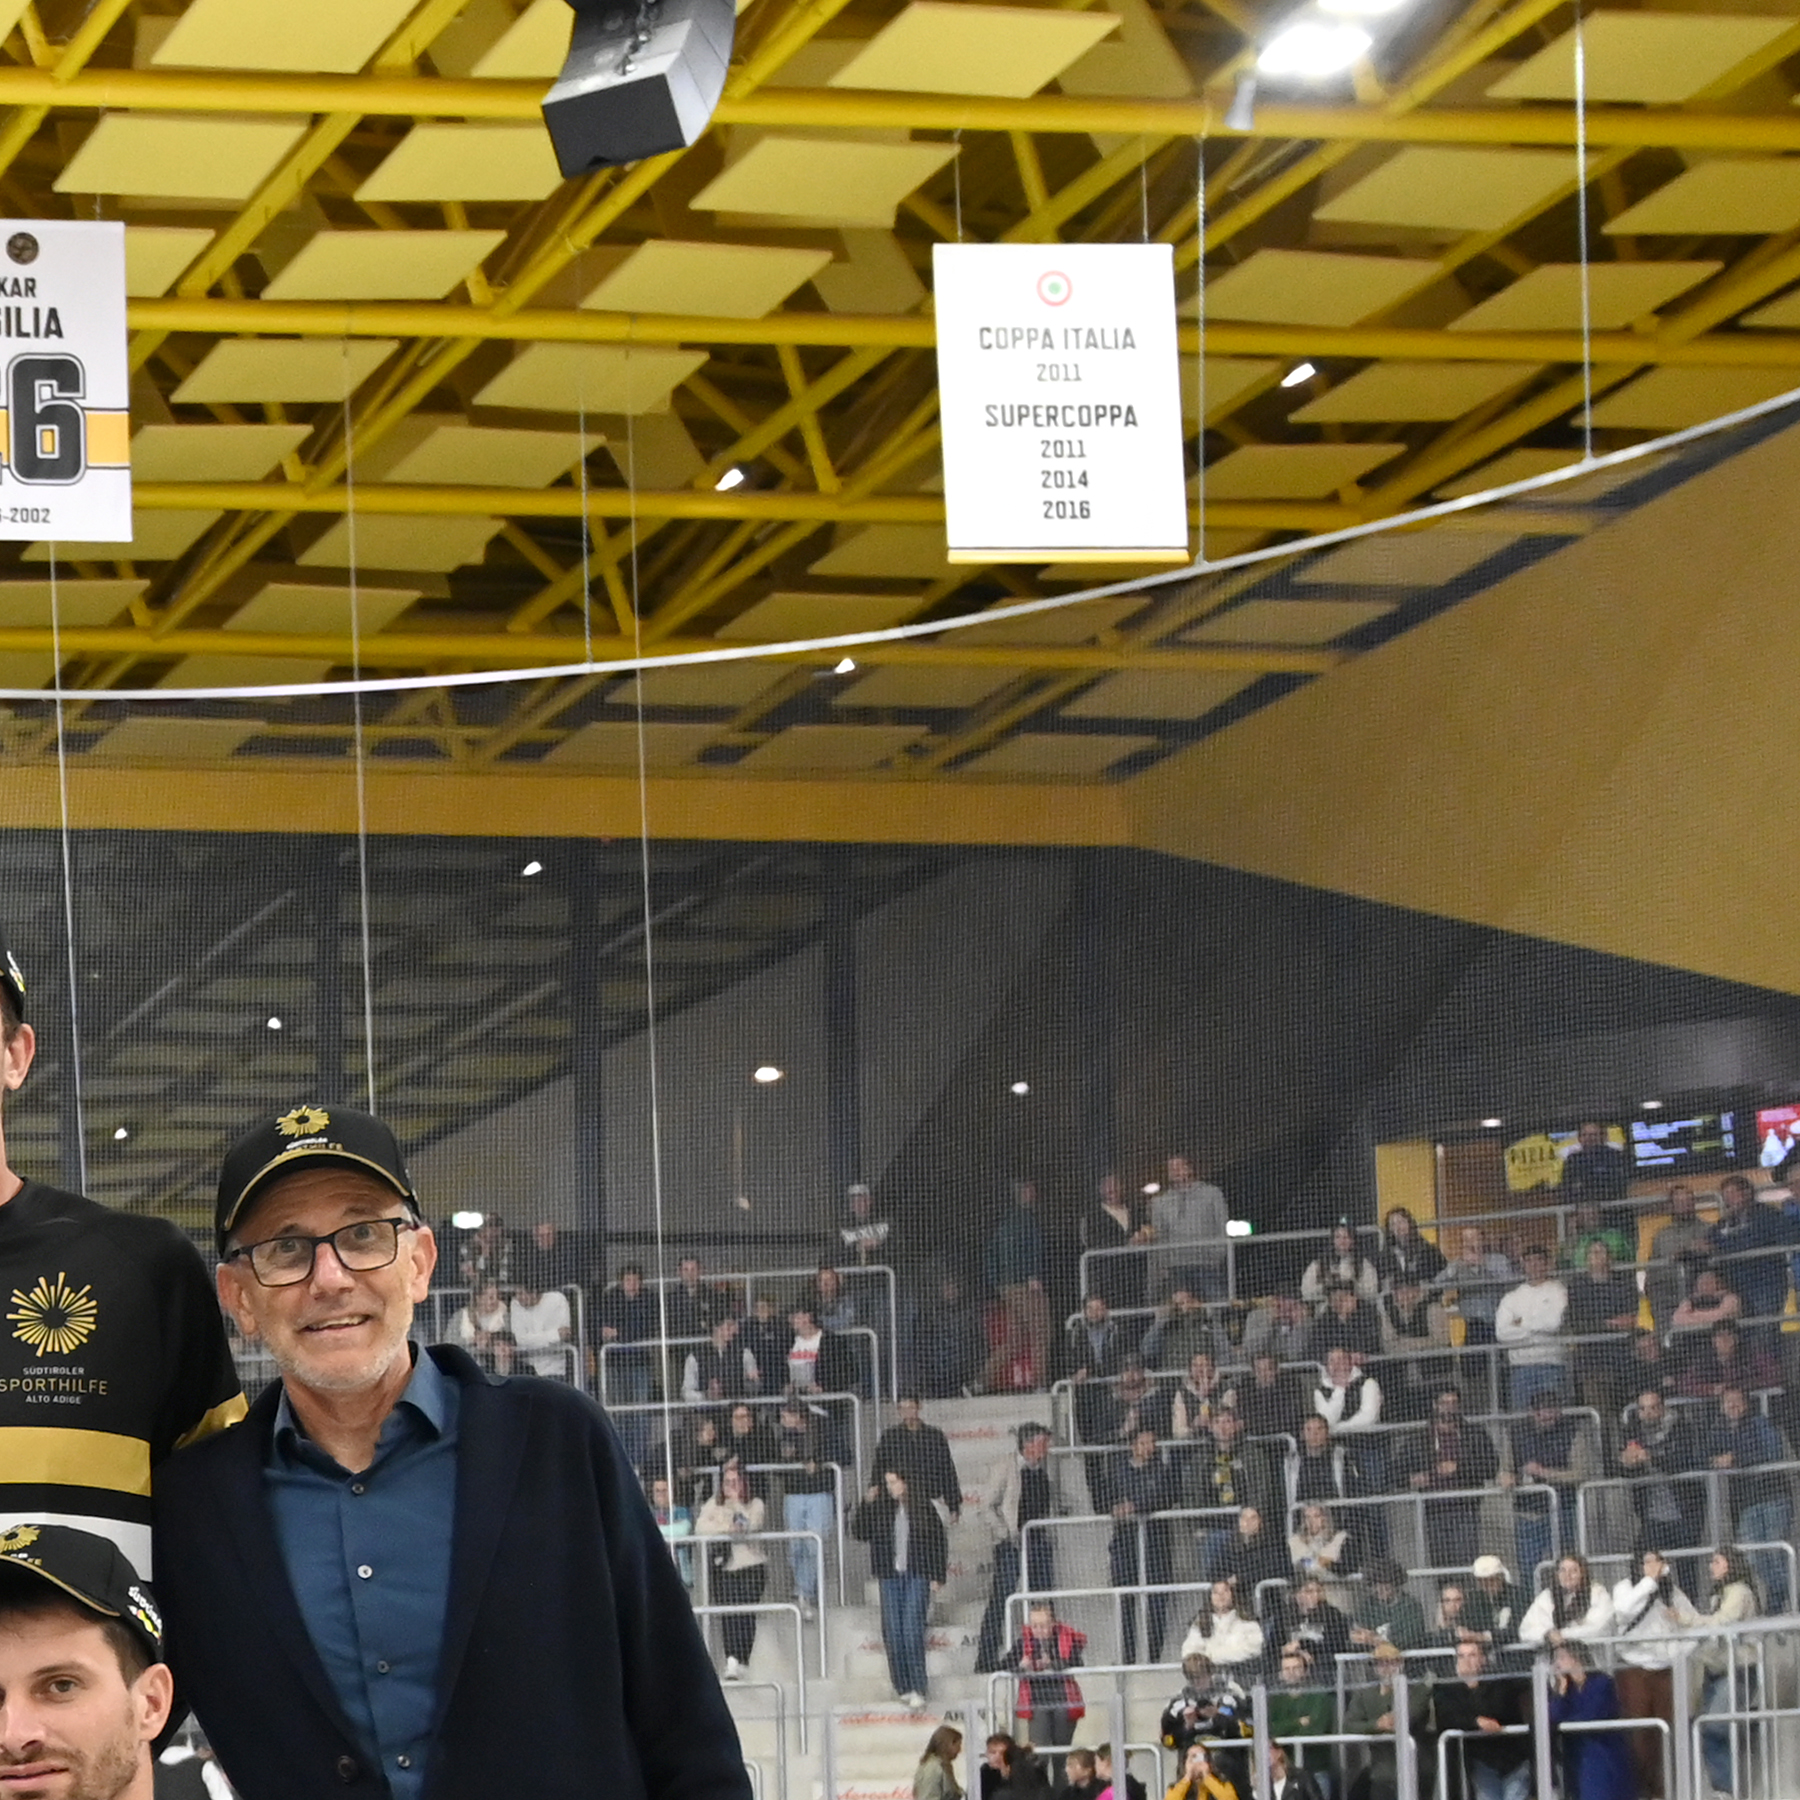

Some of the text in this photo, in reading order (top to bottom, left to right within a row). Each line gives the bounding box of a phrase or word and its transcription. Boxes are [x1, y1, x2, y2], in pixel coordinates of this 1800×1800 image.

[978, 326, 1136, 350] COPPA ITALIA
[1036, 363, 1082, 382] 2011
[985, 404, 1138, 428] SUPERCOPPA
[1040, 440, 1087, 458] 2011
[1041, 470, 1089, 488] 2014
[1043, 501, 1091, 519] 2016
[22, 1364, 85, 1376] SÜDTIROLER
[25, 1394, 82, 1405] ALTO ADIGE
